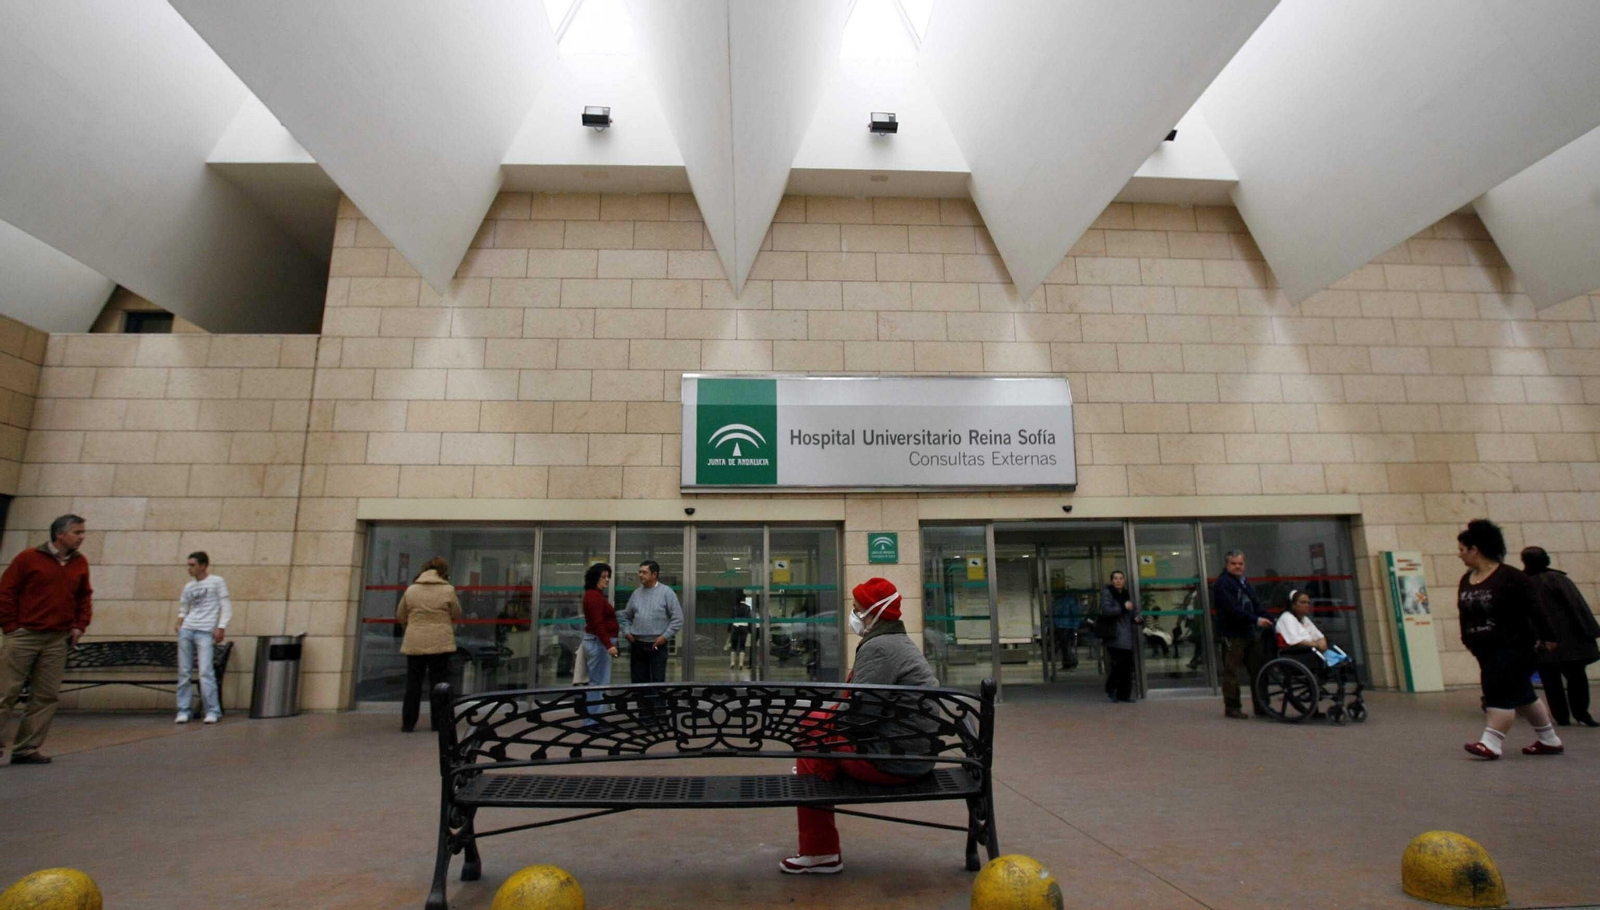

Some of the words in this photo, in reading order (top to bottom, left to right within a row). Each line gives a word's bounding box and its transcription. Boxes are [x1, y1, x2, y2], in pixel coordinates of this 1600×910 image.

[790, 429, 855, 449] Hospital
[862, 429, 962, 446] Universitario
[969, 429, 1012, 445] Reina
[1018, 428, 1056, 445] Sofía
[707, 458, 726, 466] JUNTA
[728, 458, 736, 466] DE
[909, 451, 985, 466] Consultas
[992, 451, 1057, 466] Externas
